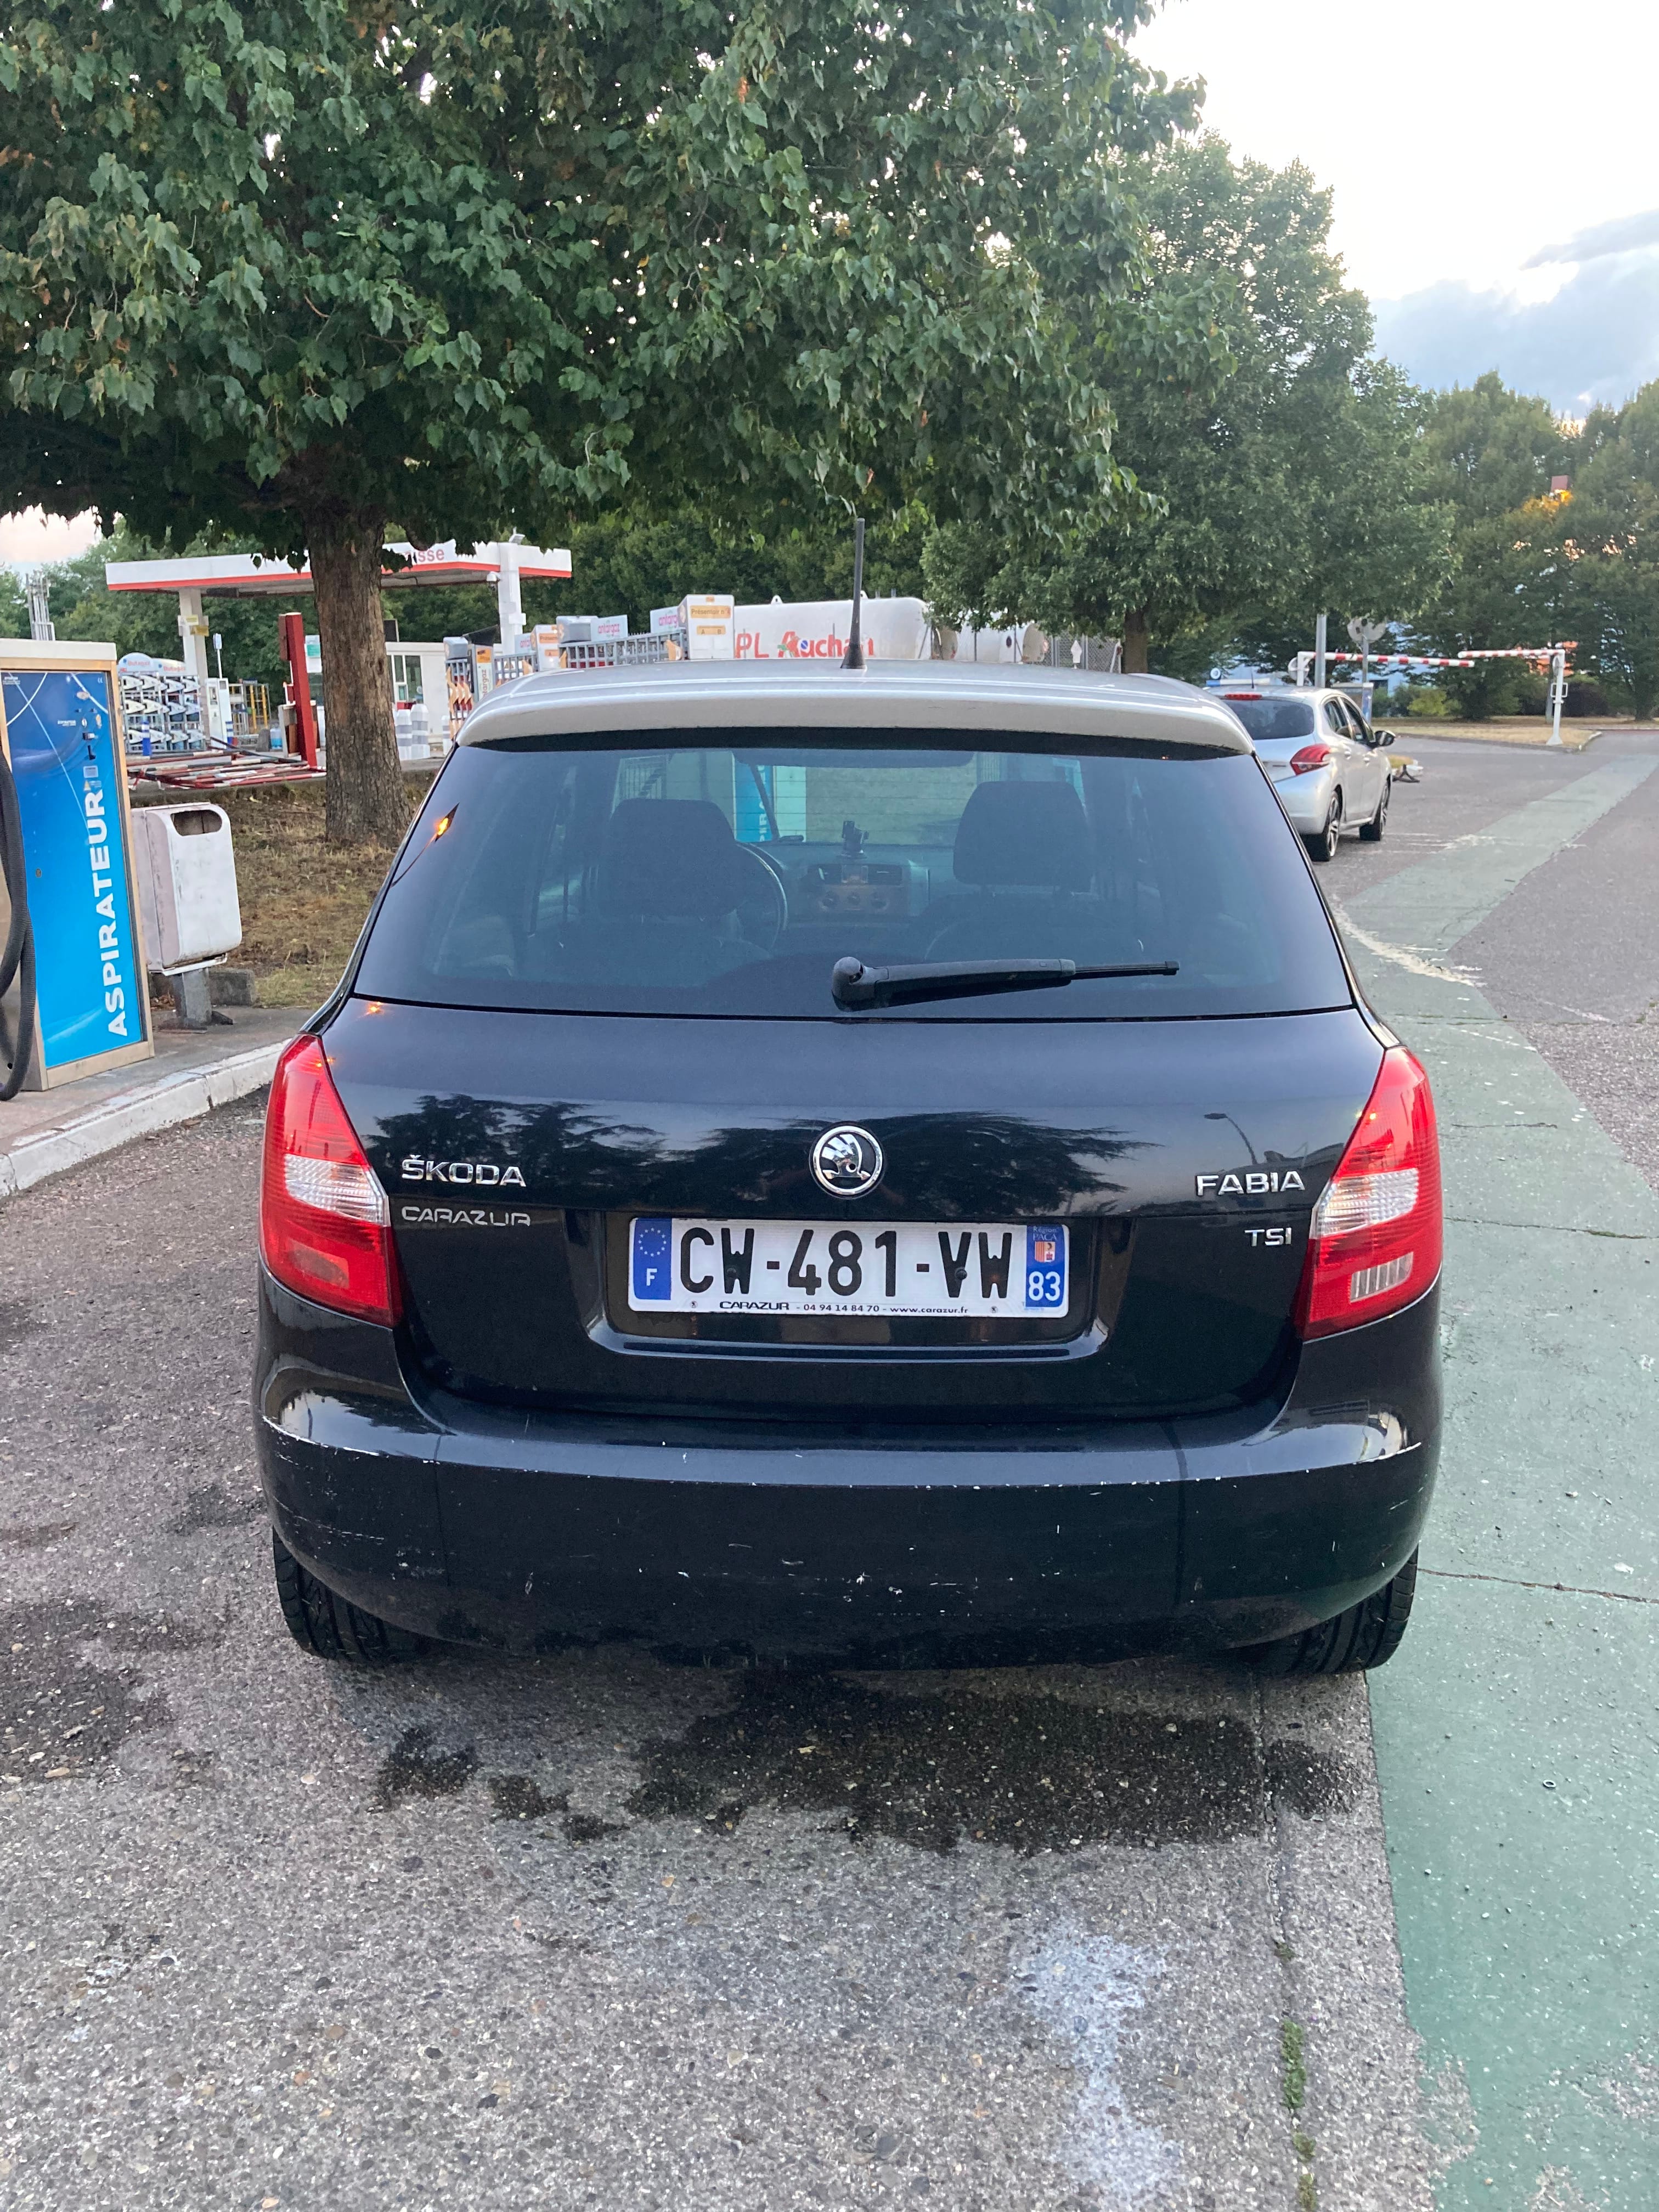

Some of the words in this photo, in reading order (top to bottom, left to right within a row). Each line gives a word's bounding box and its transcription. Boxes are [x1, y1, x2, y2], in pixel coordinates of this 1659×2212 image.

[735, 633, 769, 658] PL
[85, 789, 128, 1036] ASPIRATEUR
[402, 1154, 527, 1187] ŠKODA
[1196, 1171, 1306, 1197] FABIA
[402, 1206, 531, 1227] CARAZUR
[1033, 1226, 1057, 1234] Région
[1244, 1227, 1292, 1247] TSI
[680, 1227, 1013, 1299] CW-481-VW
[646, 1268, 658, 1286] F
[1028, 1271, 1061, 1301] 83
[719, 1301, 789, 1311] CARAZUR
